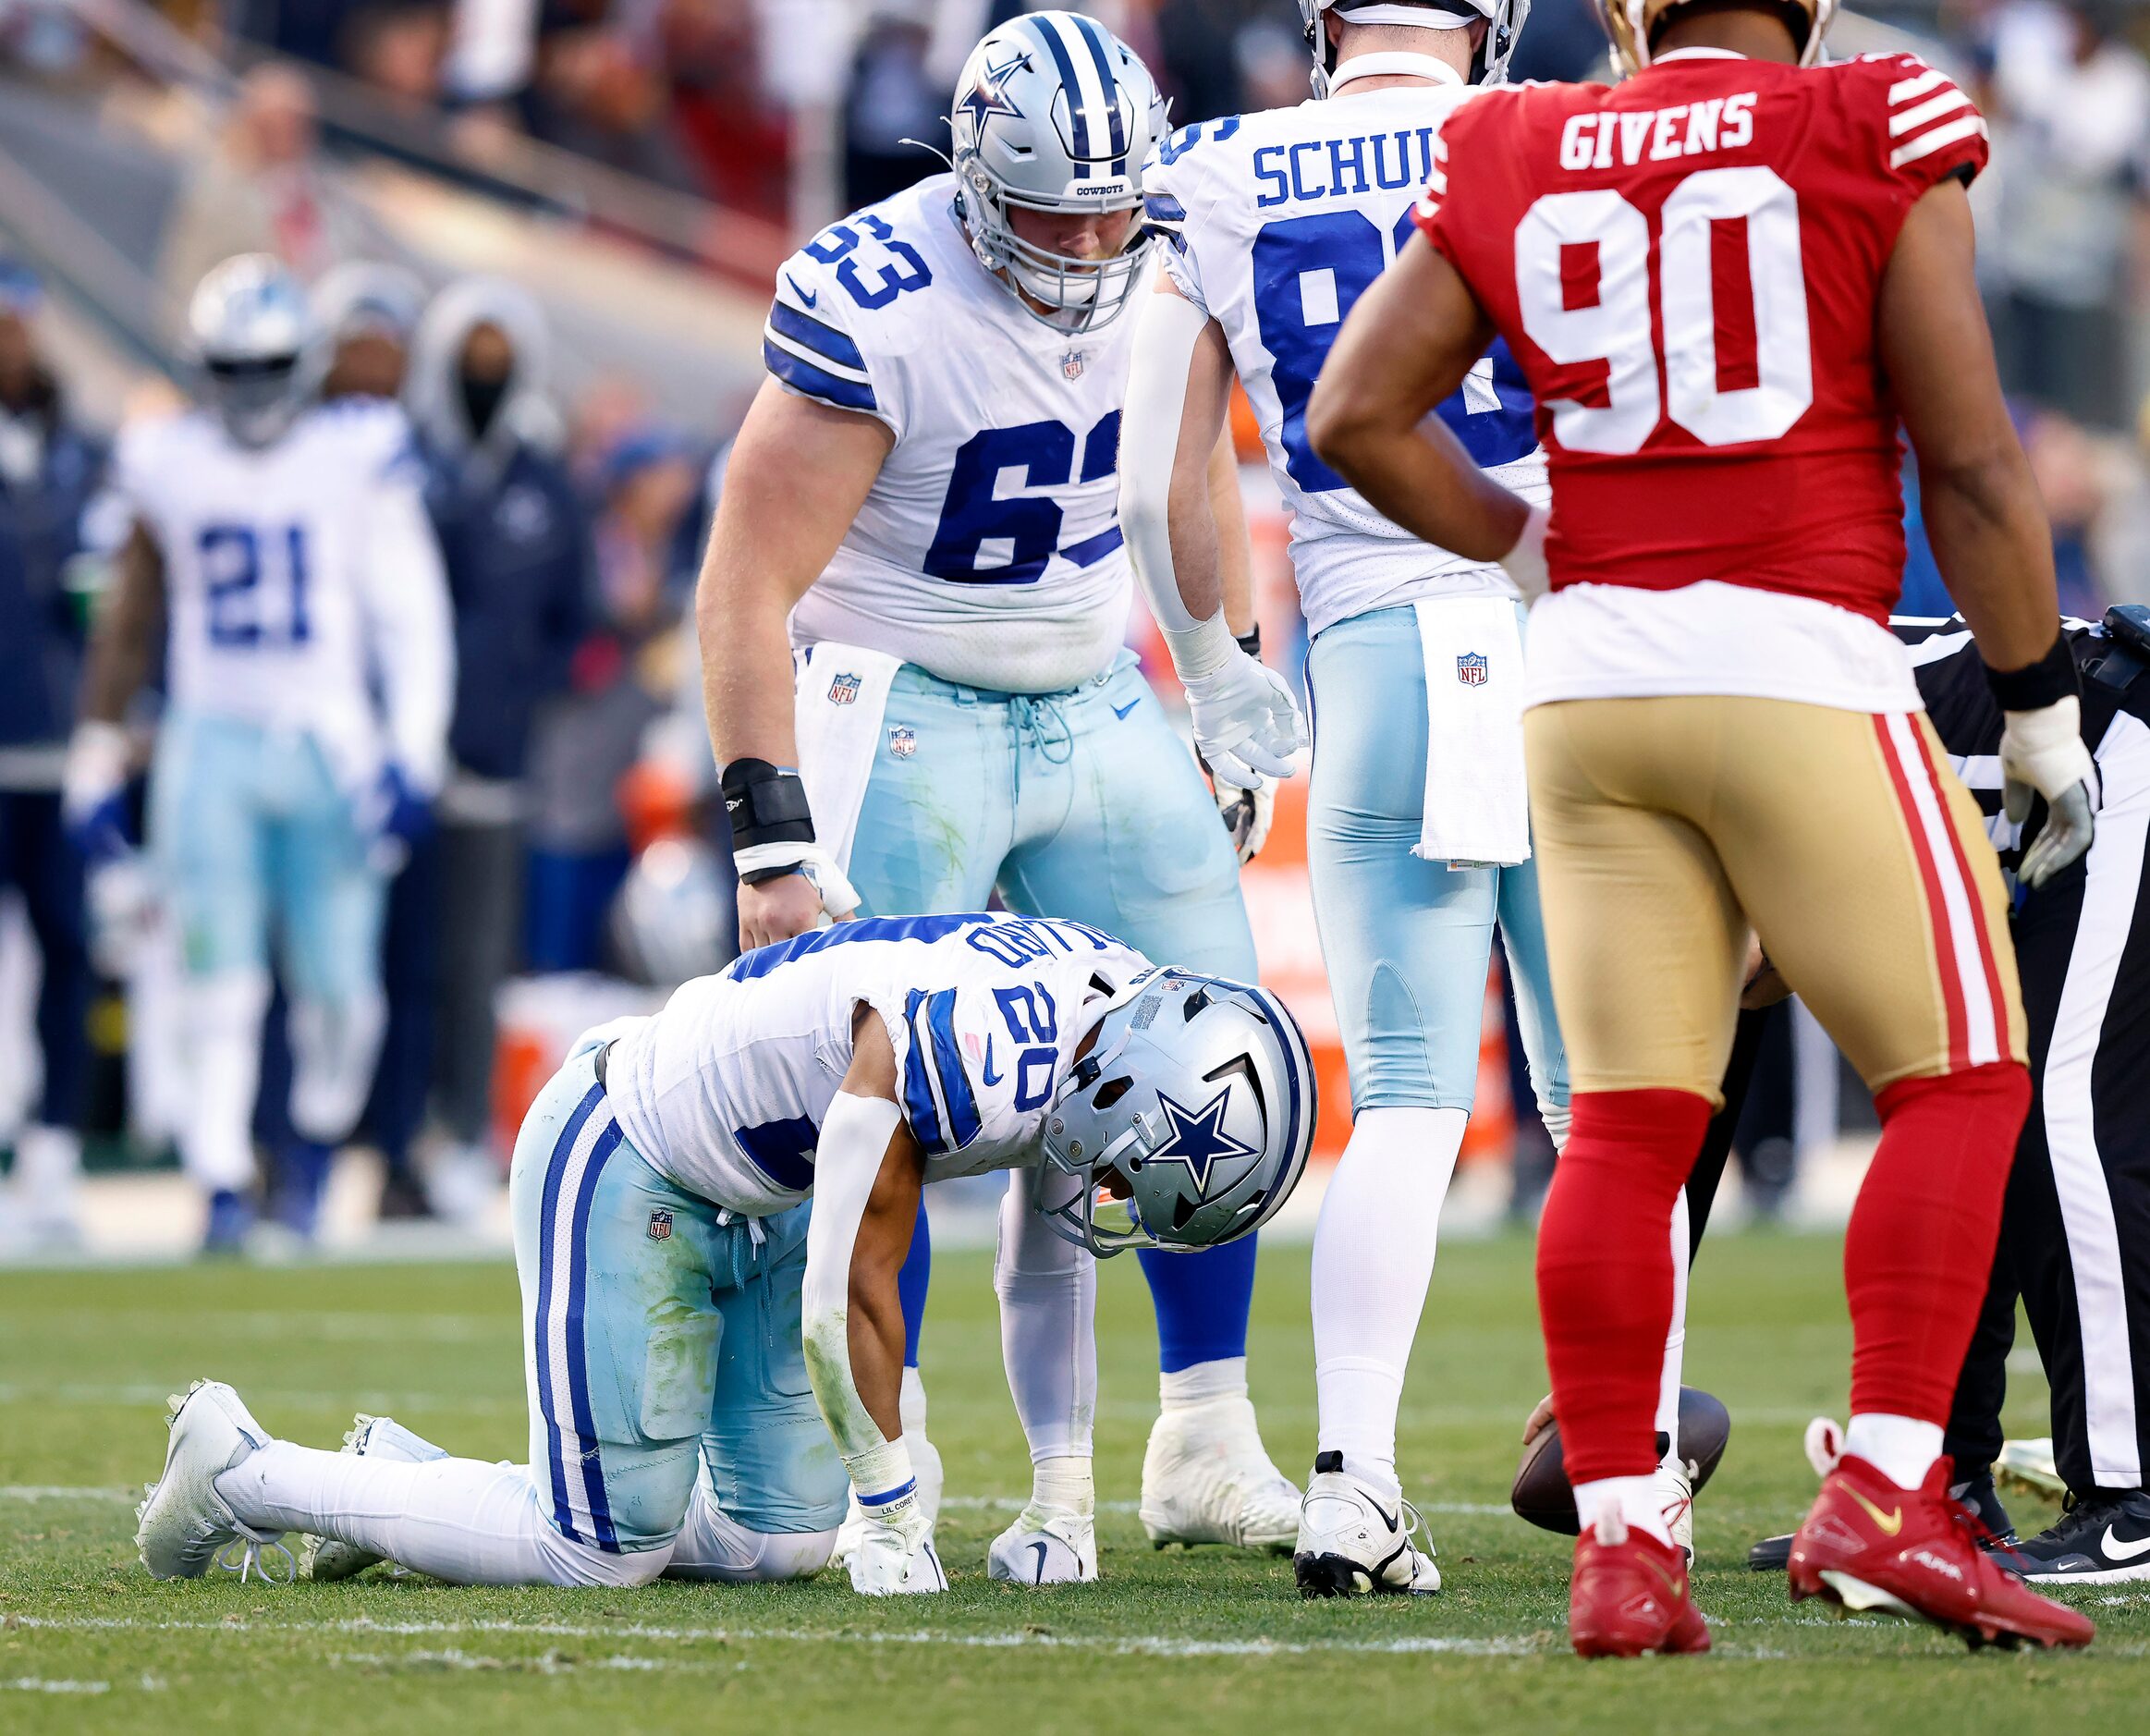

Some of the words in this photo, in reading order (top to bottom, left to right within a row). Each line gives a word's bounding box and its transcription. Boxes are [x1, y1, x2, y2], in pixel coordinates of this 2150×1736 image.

[1559, 92, 1758, 170] GIVENS
[1076, 184, 1124, 196] COWBOYS
[800, 214, 933, 310] 63
[1514, 165, 1814, 454] 90
[198, 523, 310, 644] 21
[1460, 667, 1485, 683] NFL
[831, 686, 853, 703] NFL
[893, 740, 913, 752] NFL
[991, 981, 1059, 1113] 20
[652, 1222, 670, 1237] NFL
[881, 1507, 894, 1515] LIL
[895, 1494, 914, 1510] COREY
